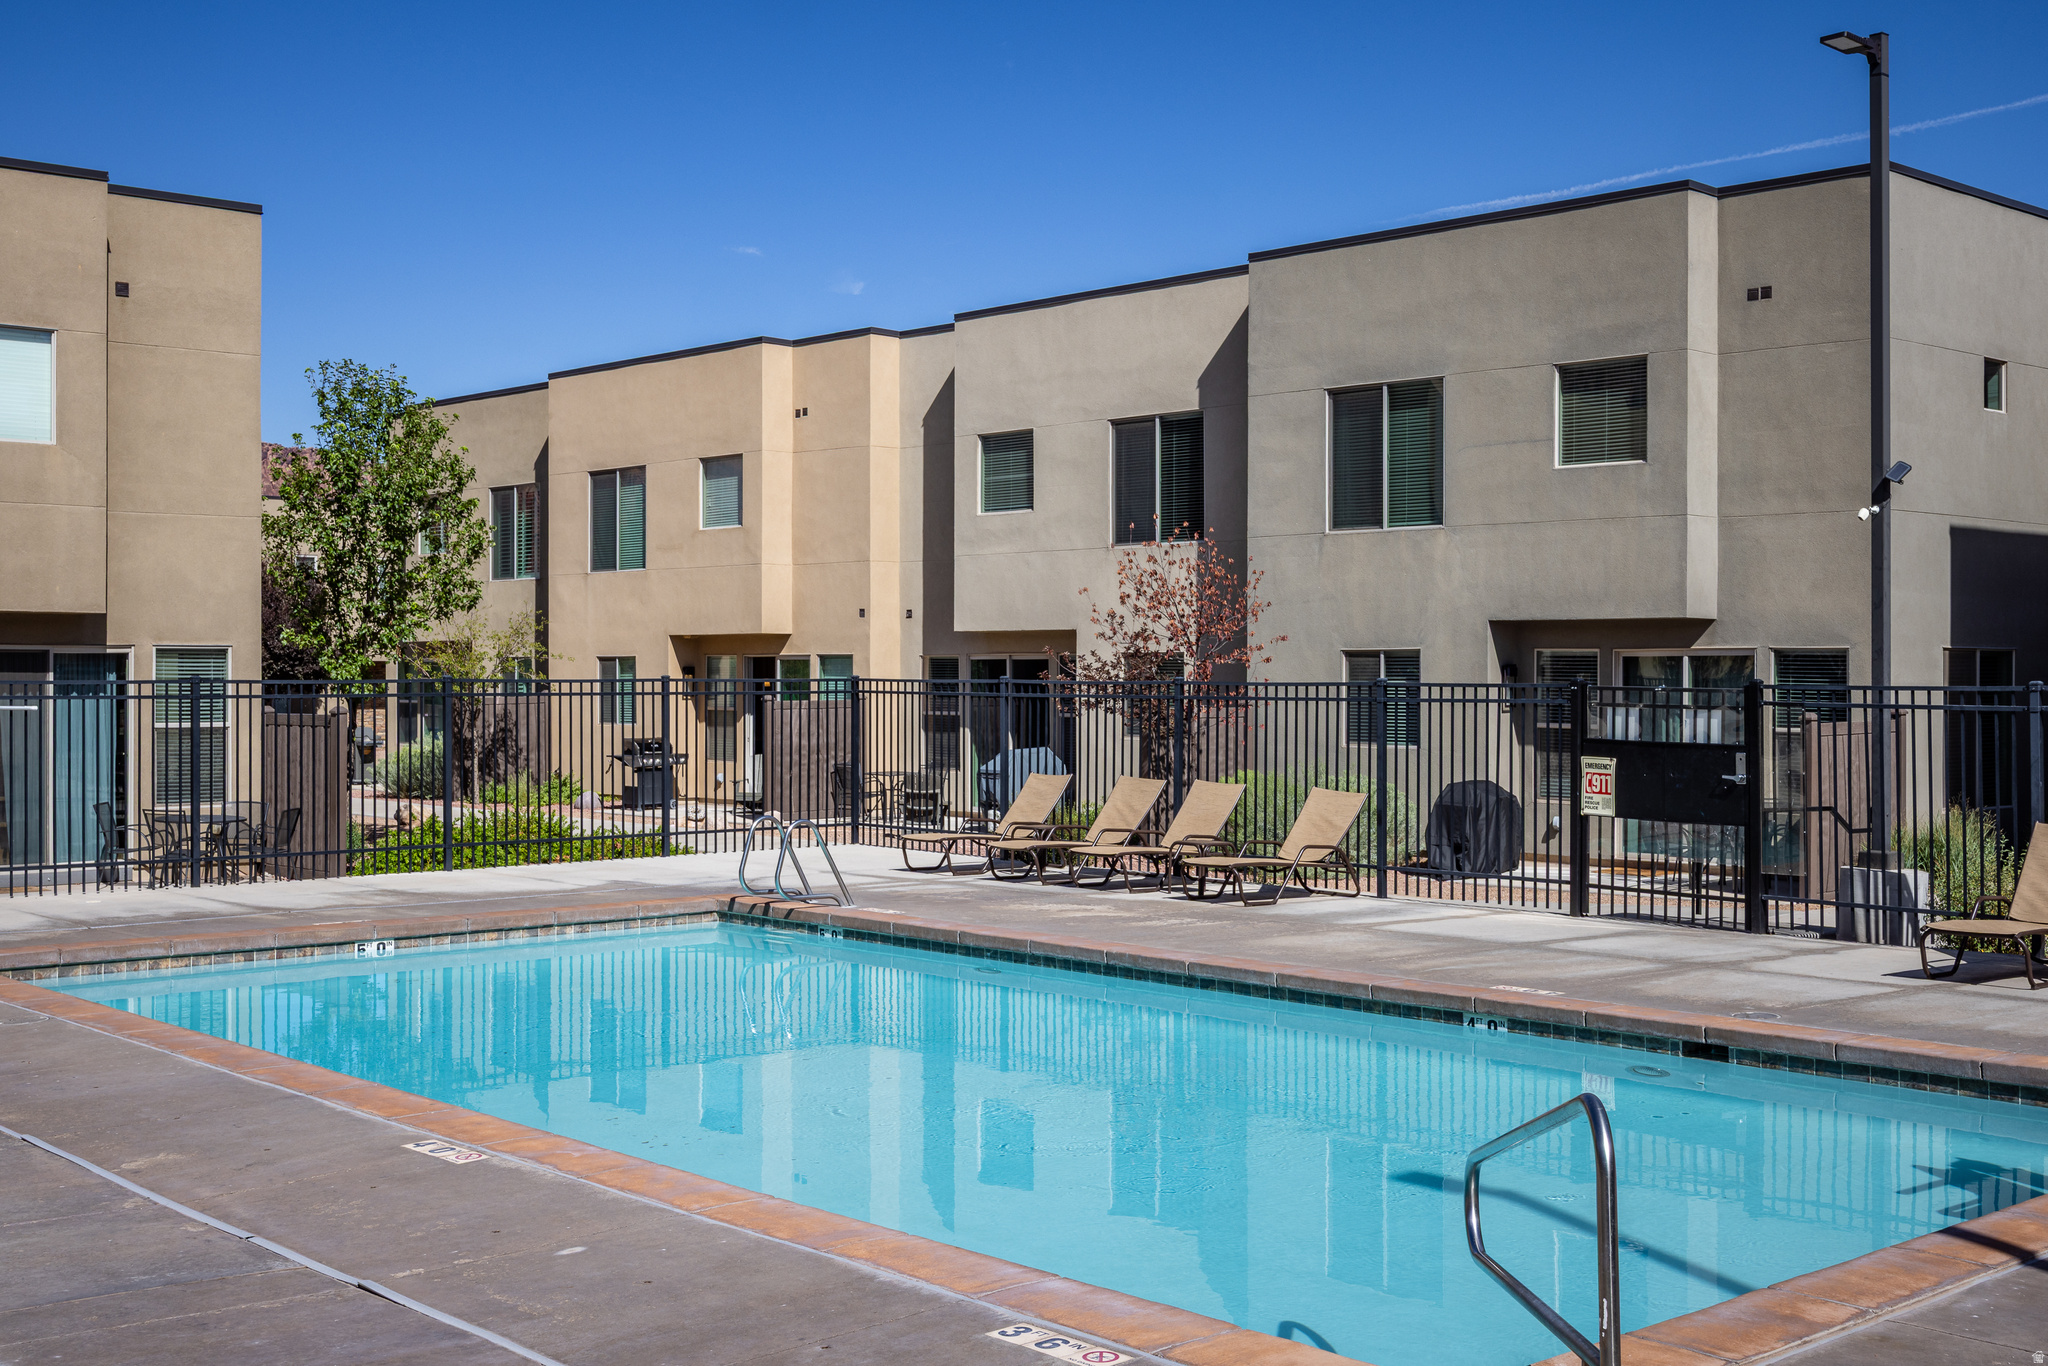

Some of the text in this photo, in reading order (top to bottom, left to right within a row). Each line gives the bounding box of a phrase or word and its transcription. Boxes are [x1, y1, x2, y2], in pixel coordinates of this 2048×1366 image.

[1585, 762, 1612, 770] EMERGENCY
[1592, 774, 1612, 793] 911
[998, 1326, 1033, 1337] 3
[1034, 1338, 1070, 1350] 6
